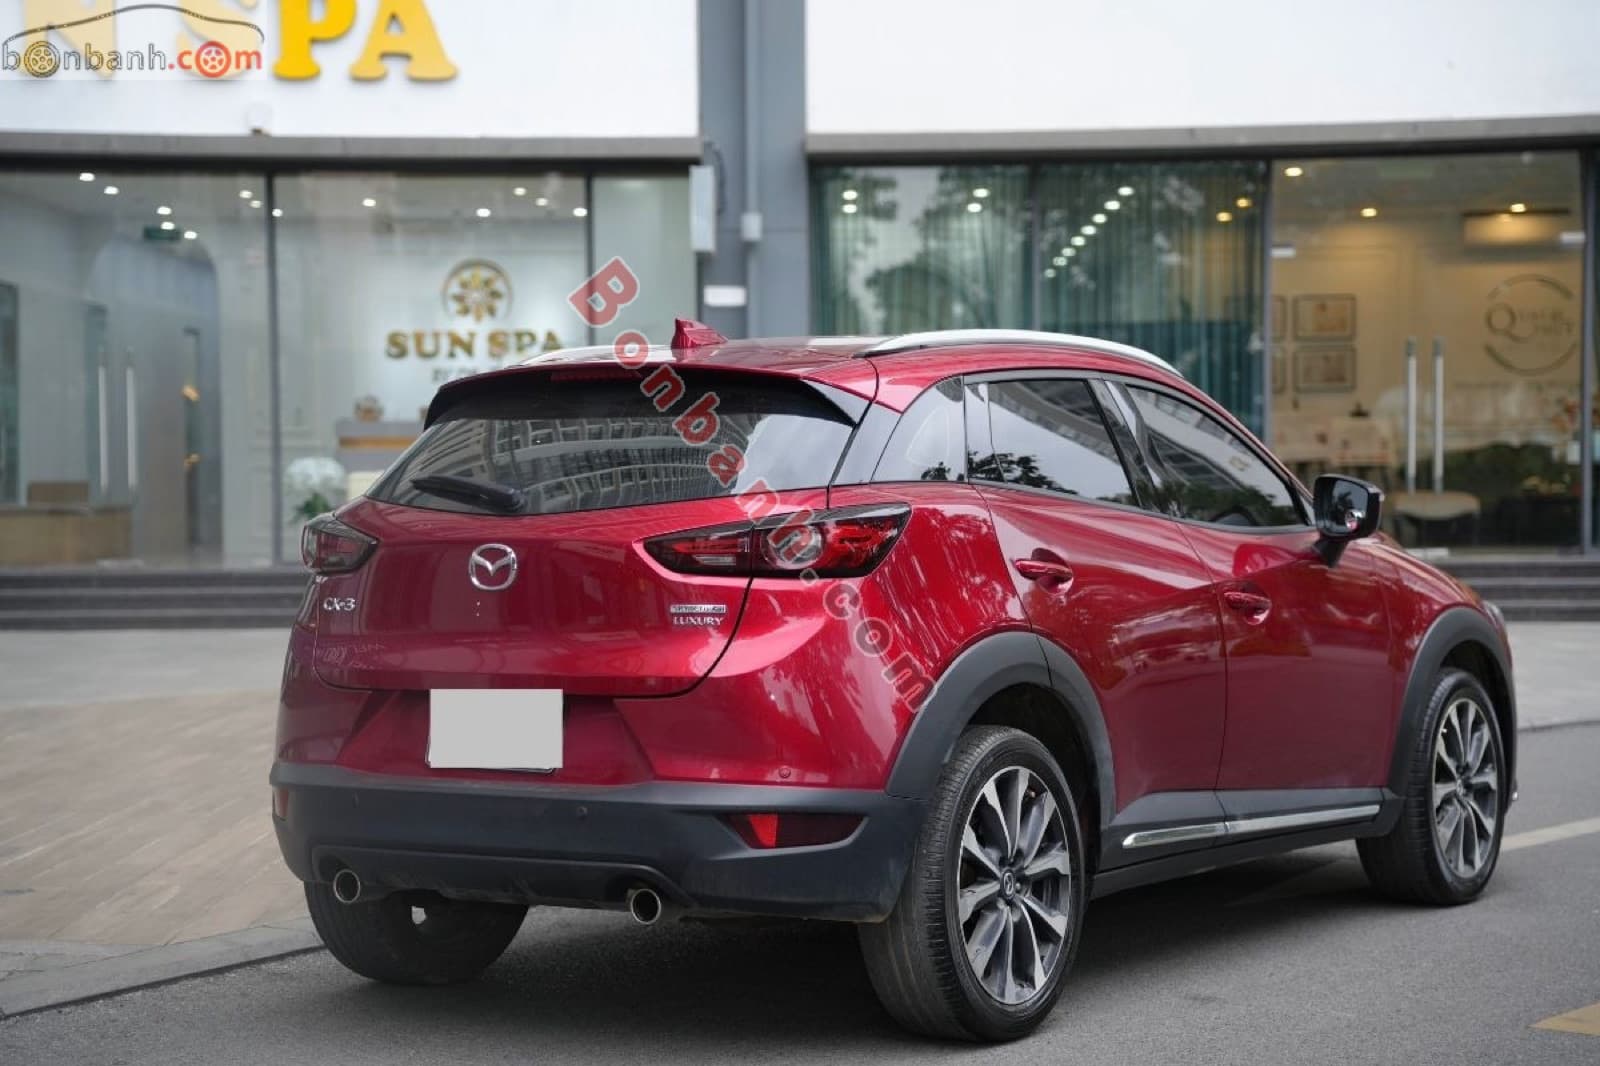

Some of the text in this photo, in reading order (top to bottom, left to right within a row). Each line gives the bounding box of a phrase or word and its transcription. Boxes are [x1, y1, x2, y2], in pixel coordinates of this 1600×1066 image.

[177, 0, 458, 81] SPA
[385, 329, 564, 359] SUN SPA
[323, 597, 356, 612] CX-3
[673, 616, 724, 626] LUXURY
